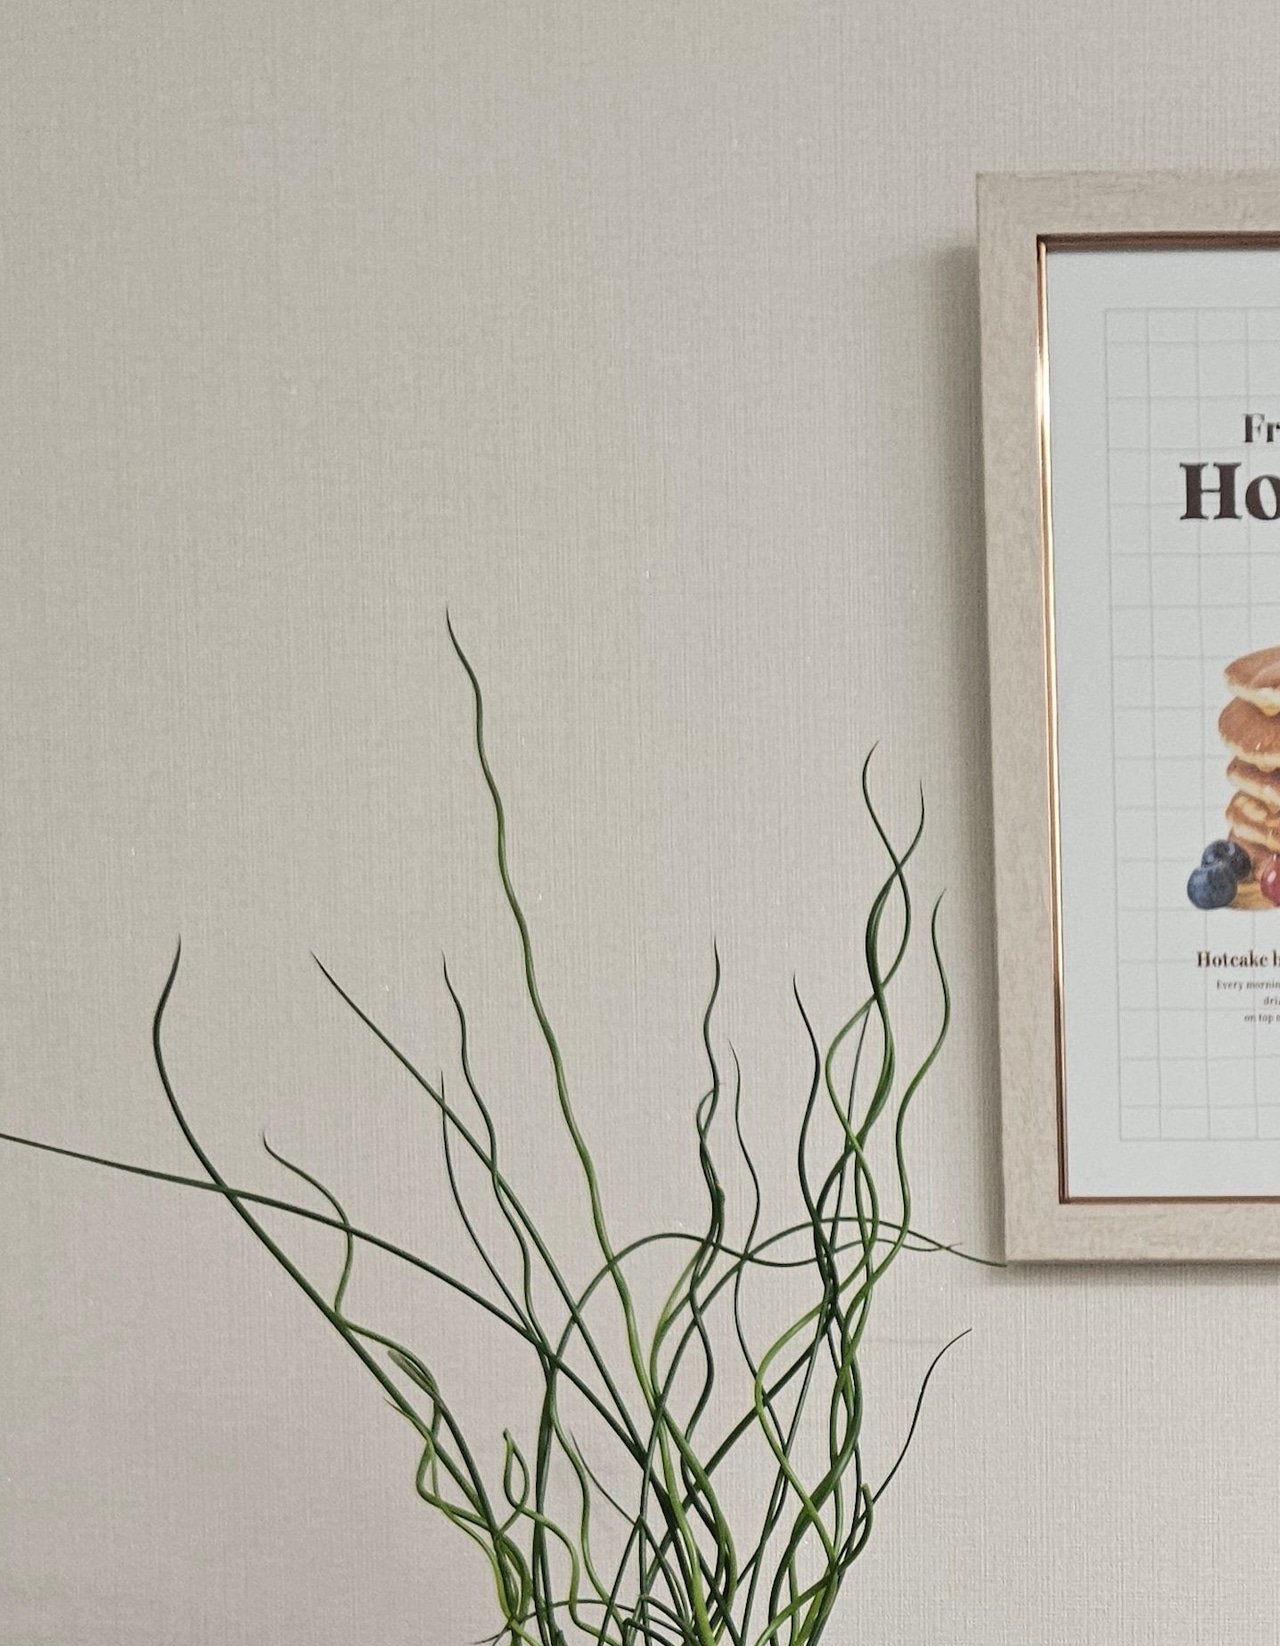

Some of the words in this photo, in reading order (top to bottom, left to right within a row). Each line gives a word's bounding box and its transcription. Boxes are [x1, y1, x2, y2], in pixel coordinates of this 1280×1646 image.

[1197, 950, 1268, 968] Hotcake
[1216, 980, 1243, 991] Every
[1244, 1014, 1256, 1022] on
[1259, 1013, 1273, 1024] top
